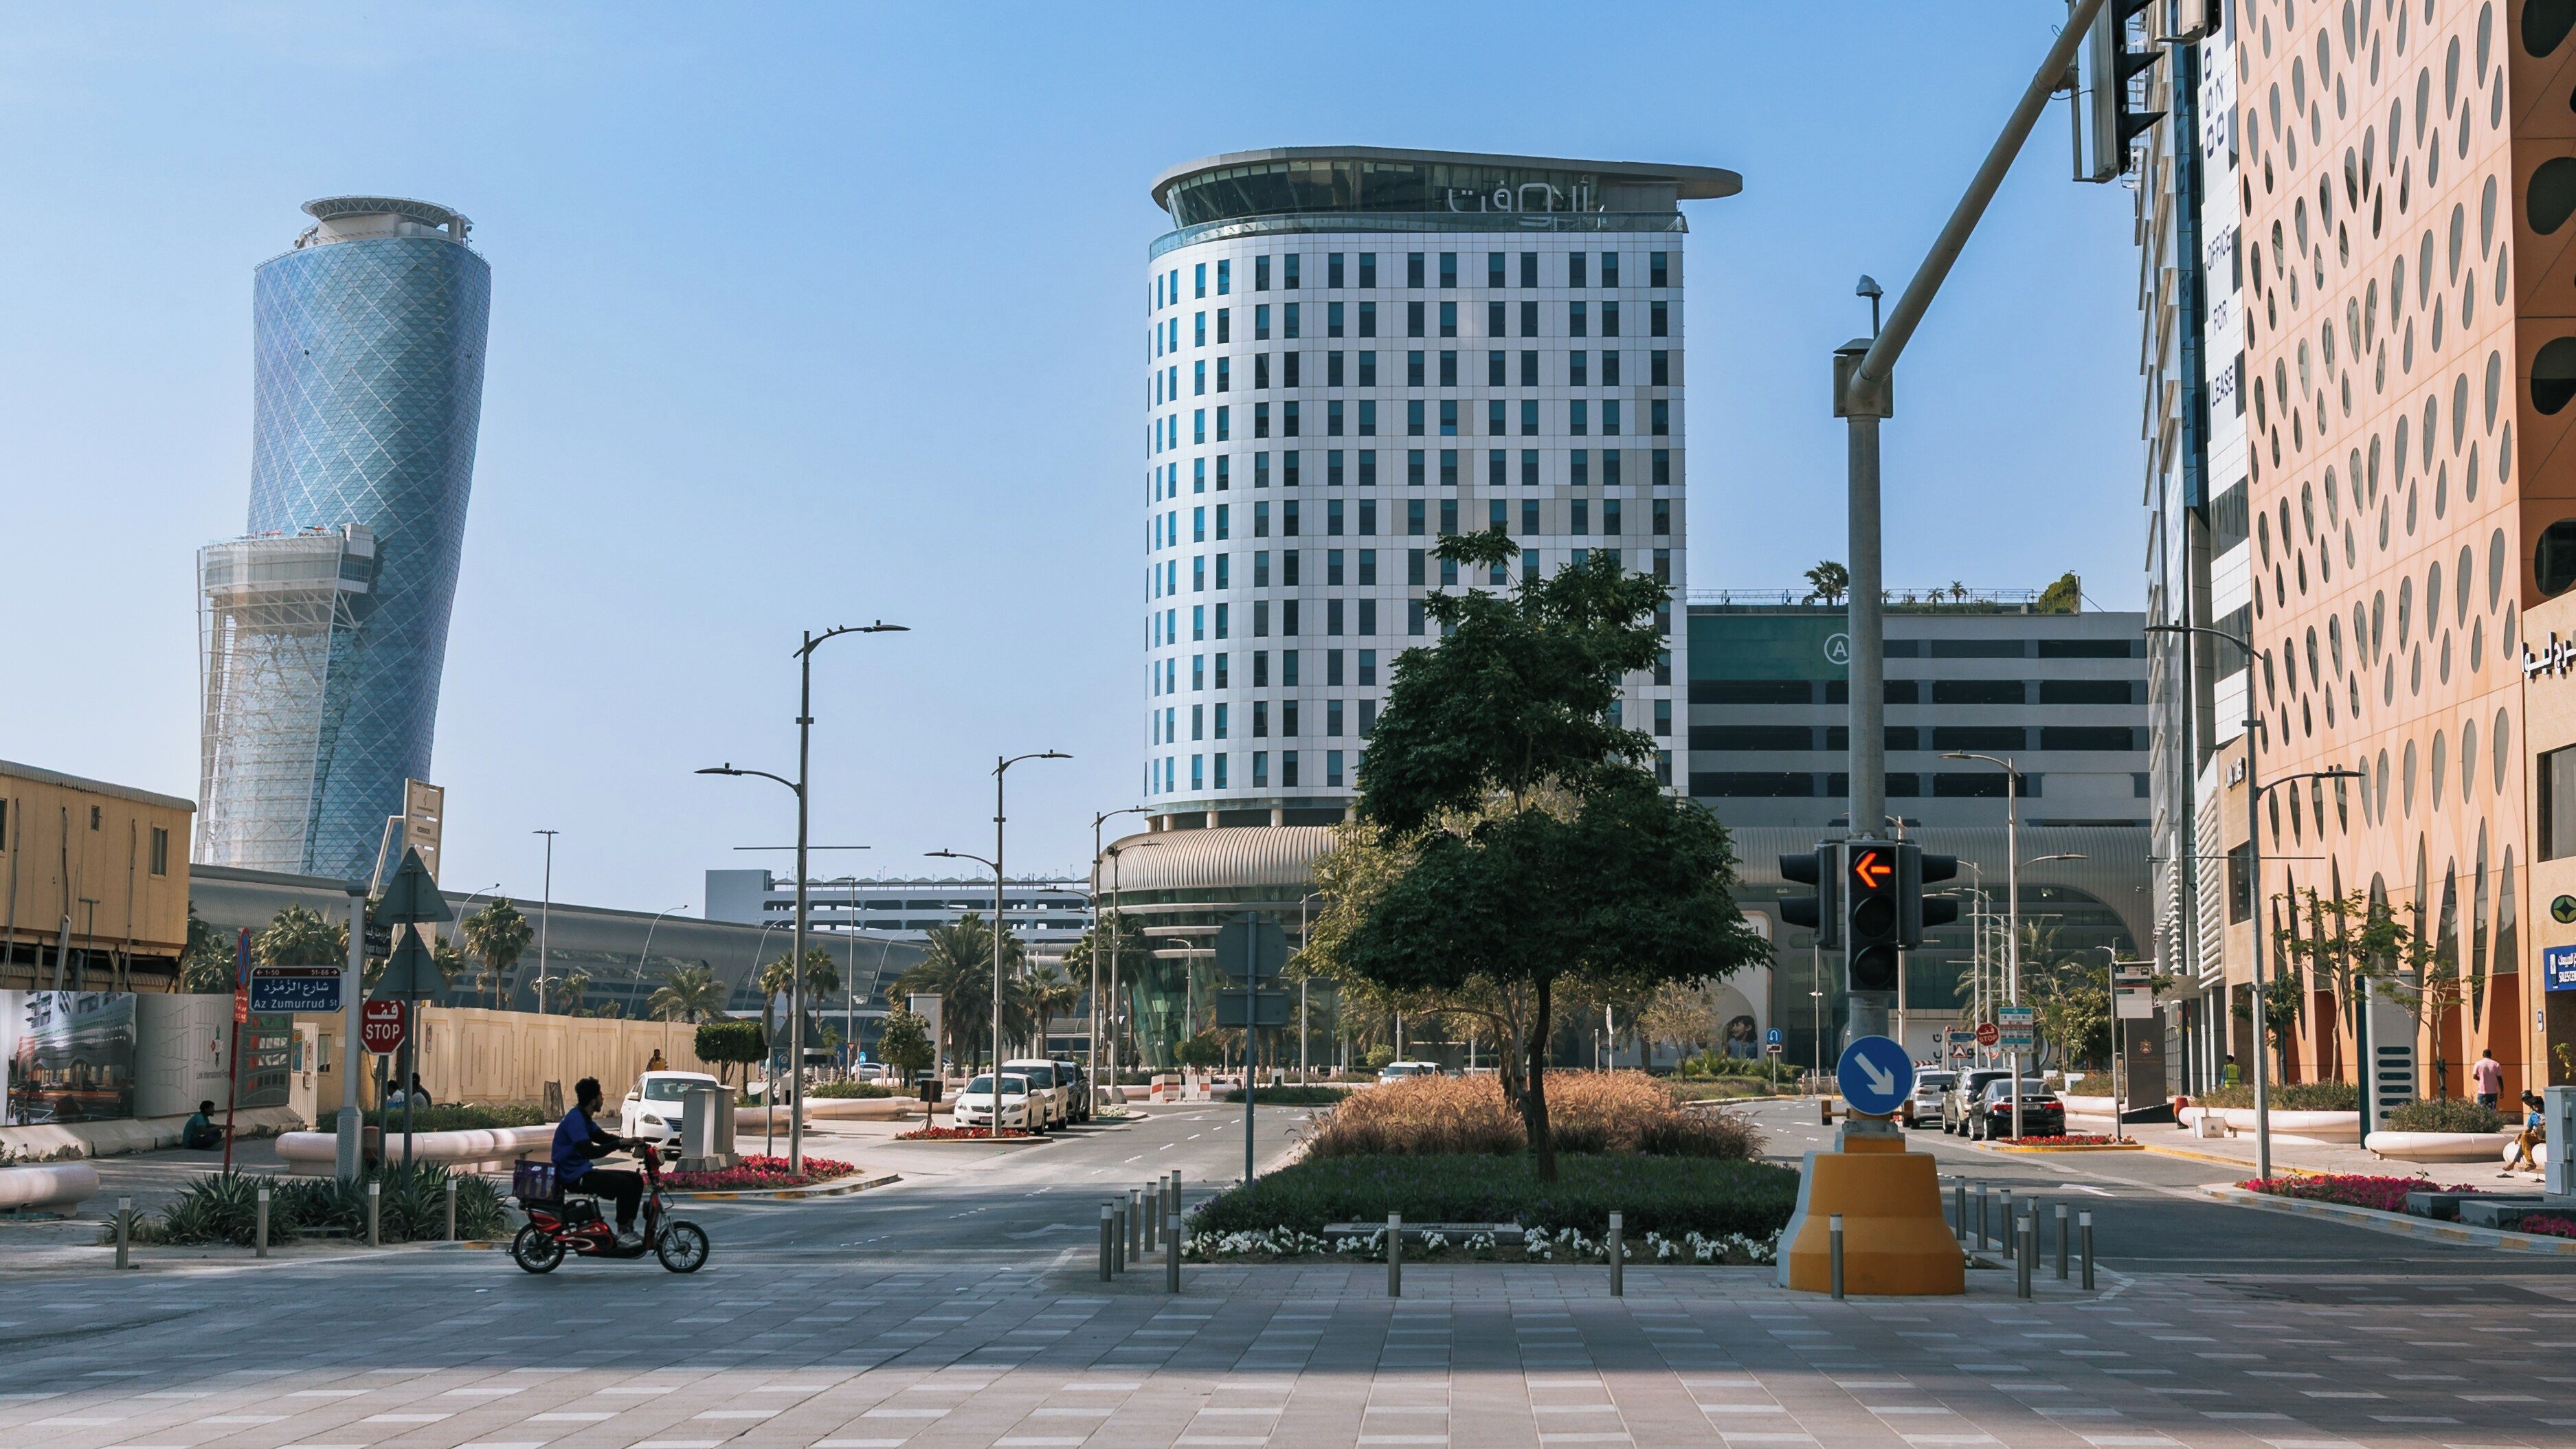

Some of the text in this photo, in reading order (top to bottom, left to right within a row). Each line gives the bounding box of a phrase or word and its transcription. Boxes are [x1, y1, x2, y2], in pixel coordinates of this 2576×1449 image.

[2207, 224, 2231, 271] OFFICE
[2213, 300, 2228, 336] FOR
[2212, 365, 2233, 407] LEASE
[1832, 640, 1848, 657] A
[303, 980, 329, 996] شارع
[254, 1000, 266, 1008] Az
[271, 998, 325, 1009] Zumurrud
[367, 1000, 399, 1020] قف
[366, 1023, 401, 1040] STOP
[1978, 1034, 1997, 1043] STOP
